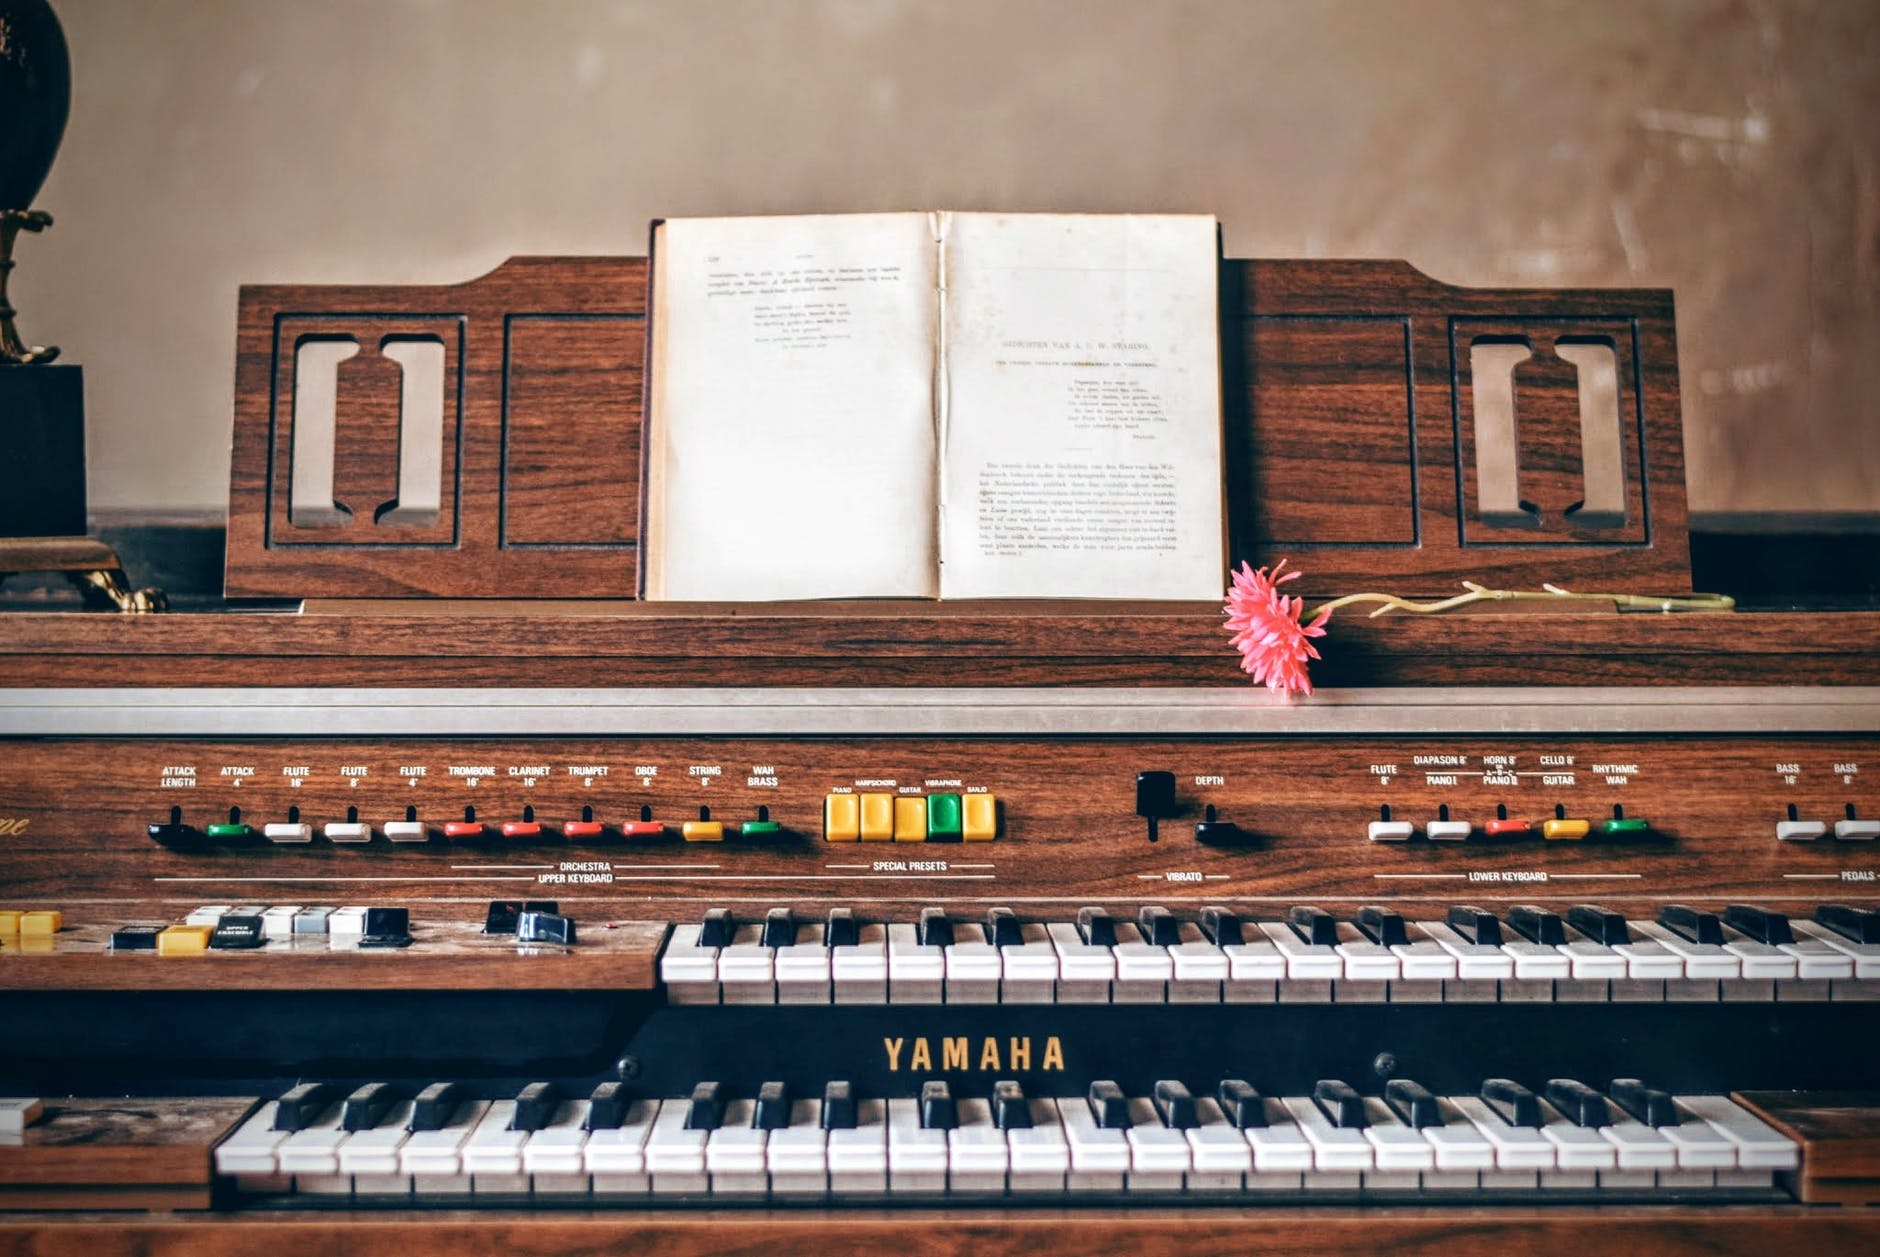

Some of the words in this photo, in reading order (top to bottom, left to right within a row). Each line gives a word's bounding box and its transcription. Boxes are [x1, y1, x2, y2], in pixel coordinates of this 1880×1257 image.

[1414, 755, 1458, 765] DIAPASON
[1484, 755, 1507, 765] HORN
[1540, 755, 1565, 765] CELLO
[162, 766, 196, 776] ATTACK
[221, 766, 254, 776] ATTACK
[283, 766, 309, 777] FLUTE
[341, 765, 368, 776] FLUTE
[400, 765, 427, 776] FLUTE
[448, 765, 495, 776] TROMBONE
[509, 765, 550, 776] CLARINET
[568, 765, 608, 776] TRUMPET
[635, 765, 657, 776] OBOE
[689, 765, 721, 775] STRING
[752, 765, 775, 775] WAH
[1371, 764, 1397, 774] FLUTE
[1593, 764, 1638, 774] RHYTHMIC
[1777, 763, 1799, 773] BASS
[1835, 763, 1857, 773] BASS
[161, 777, 196, 787] LENGTH
[748, 776, 778, 787] BRASS
[1196, 775, 1224, 785] DEPTH
[1427, 775, 1452, 785] PIANO
[1483, 775, 1510, 785] PIANO
[1543, 775, 1575, 785] GUITAR
[1605, 775, 1628, 785] WAH
[833, 786, 852, 794] PIANO
[899, 786, 921, 794] GUITAR
[560, 861, 610, 871] ORCHESTRA
[873, 861, 907, 871] SPECIAL
[909, 860, 947, 871] PRESETS
[538, 873, 565, 883] UPPER
[568, 873, 612, 883] KEYBOARD
[1166, 871, 1202, 881] VIBRATO
[1469, 871, 1500, 881] LOWER
[1502, 871, 1547, 881] KEYBOARD
[1842, 871, 1874, 881] PEDALS
[884, 1037, 1064, 1070] YAMAHA
